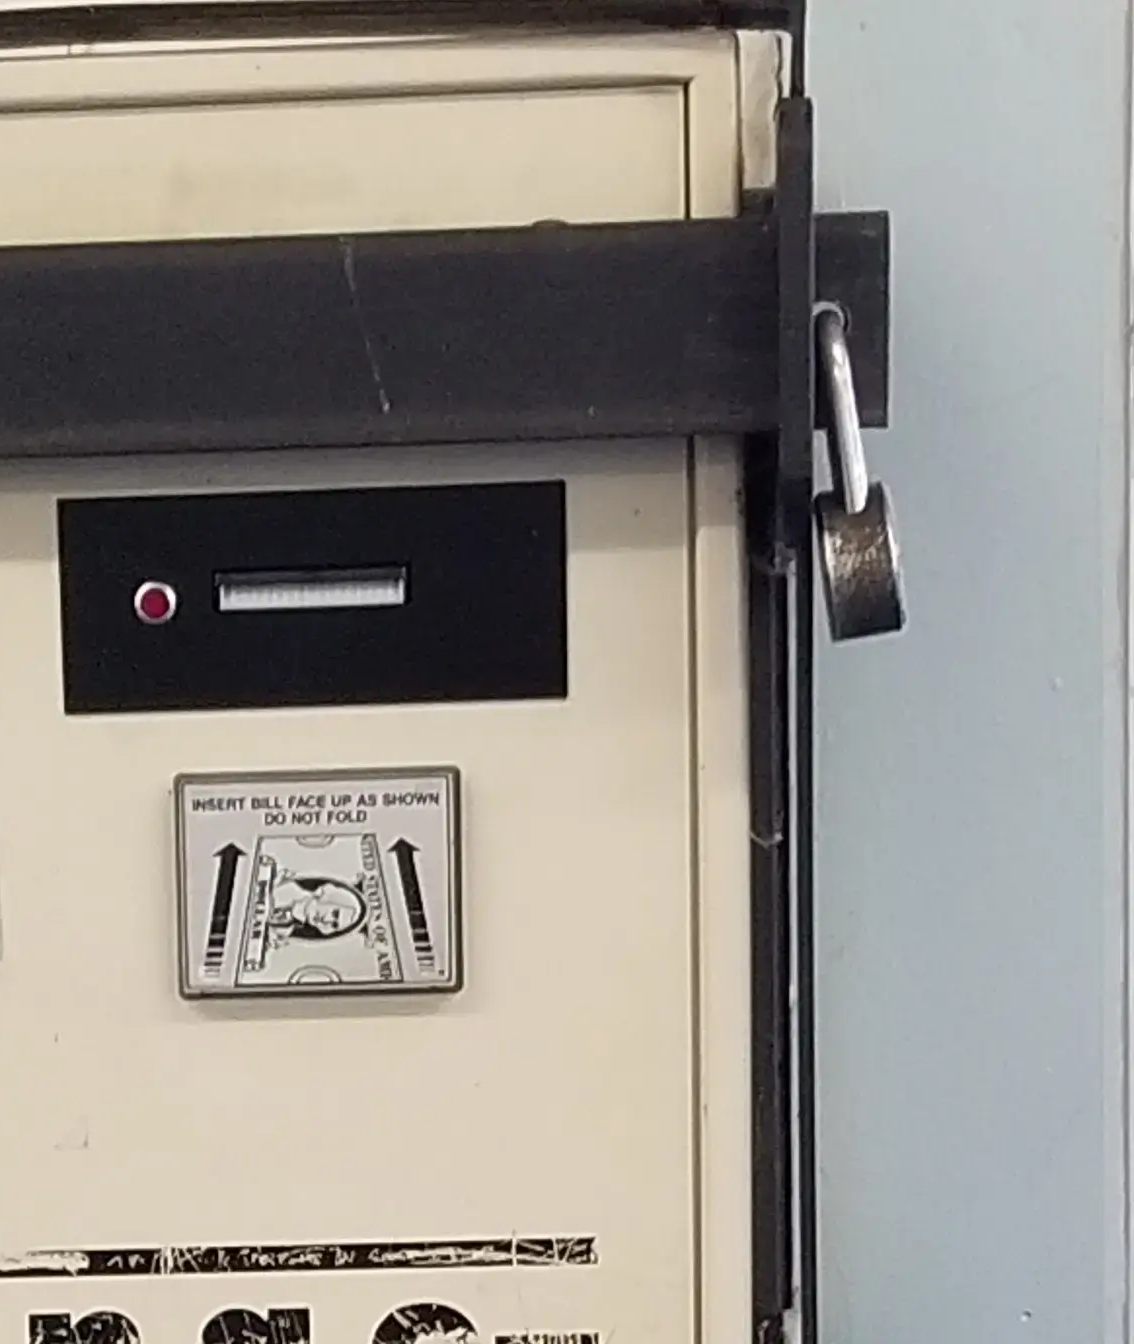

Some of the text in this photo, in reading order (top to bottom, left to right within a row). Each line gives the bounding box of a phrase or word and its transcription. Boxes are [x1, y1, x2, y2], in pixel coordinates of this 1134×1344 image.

[192, 792, 440, 812] INSERT BILL FACE UP AS SHOWN
[264, 810, 367, 826] DO NOT FOLD
